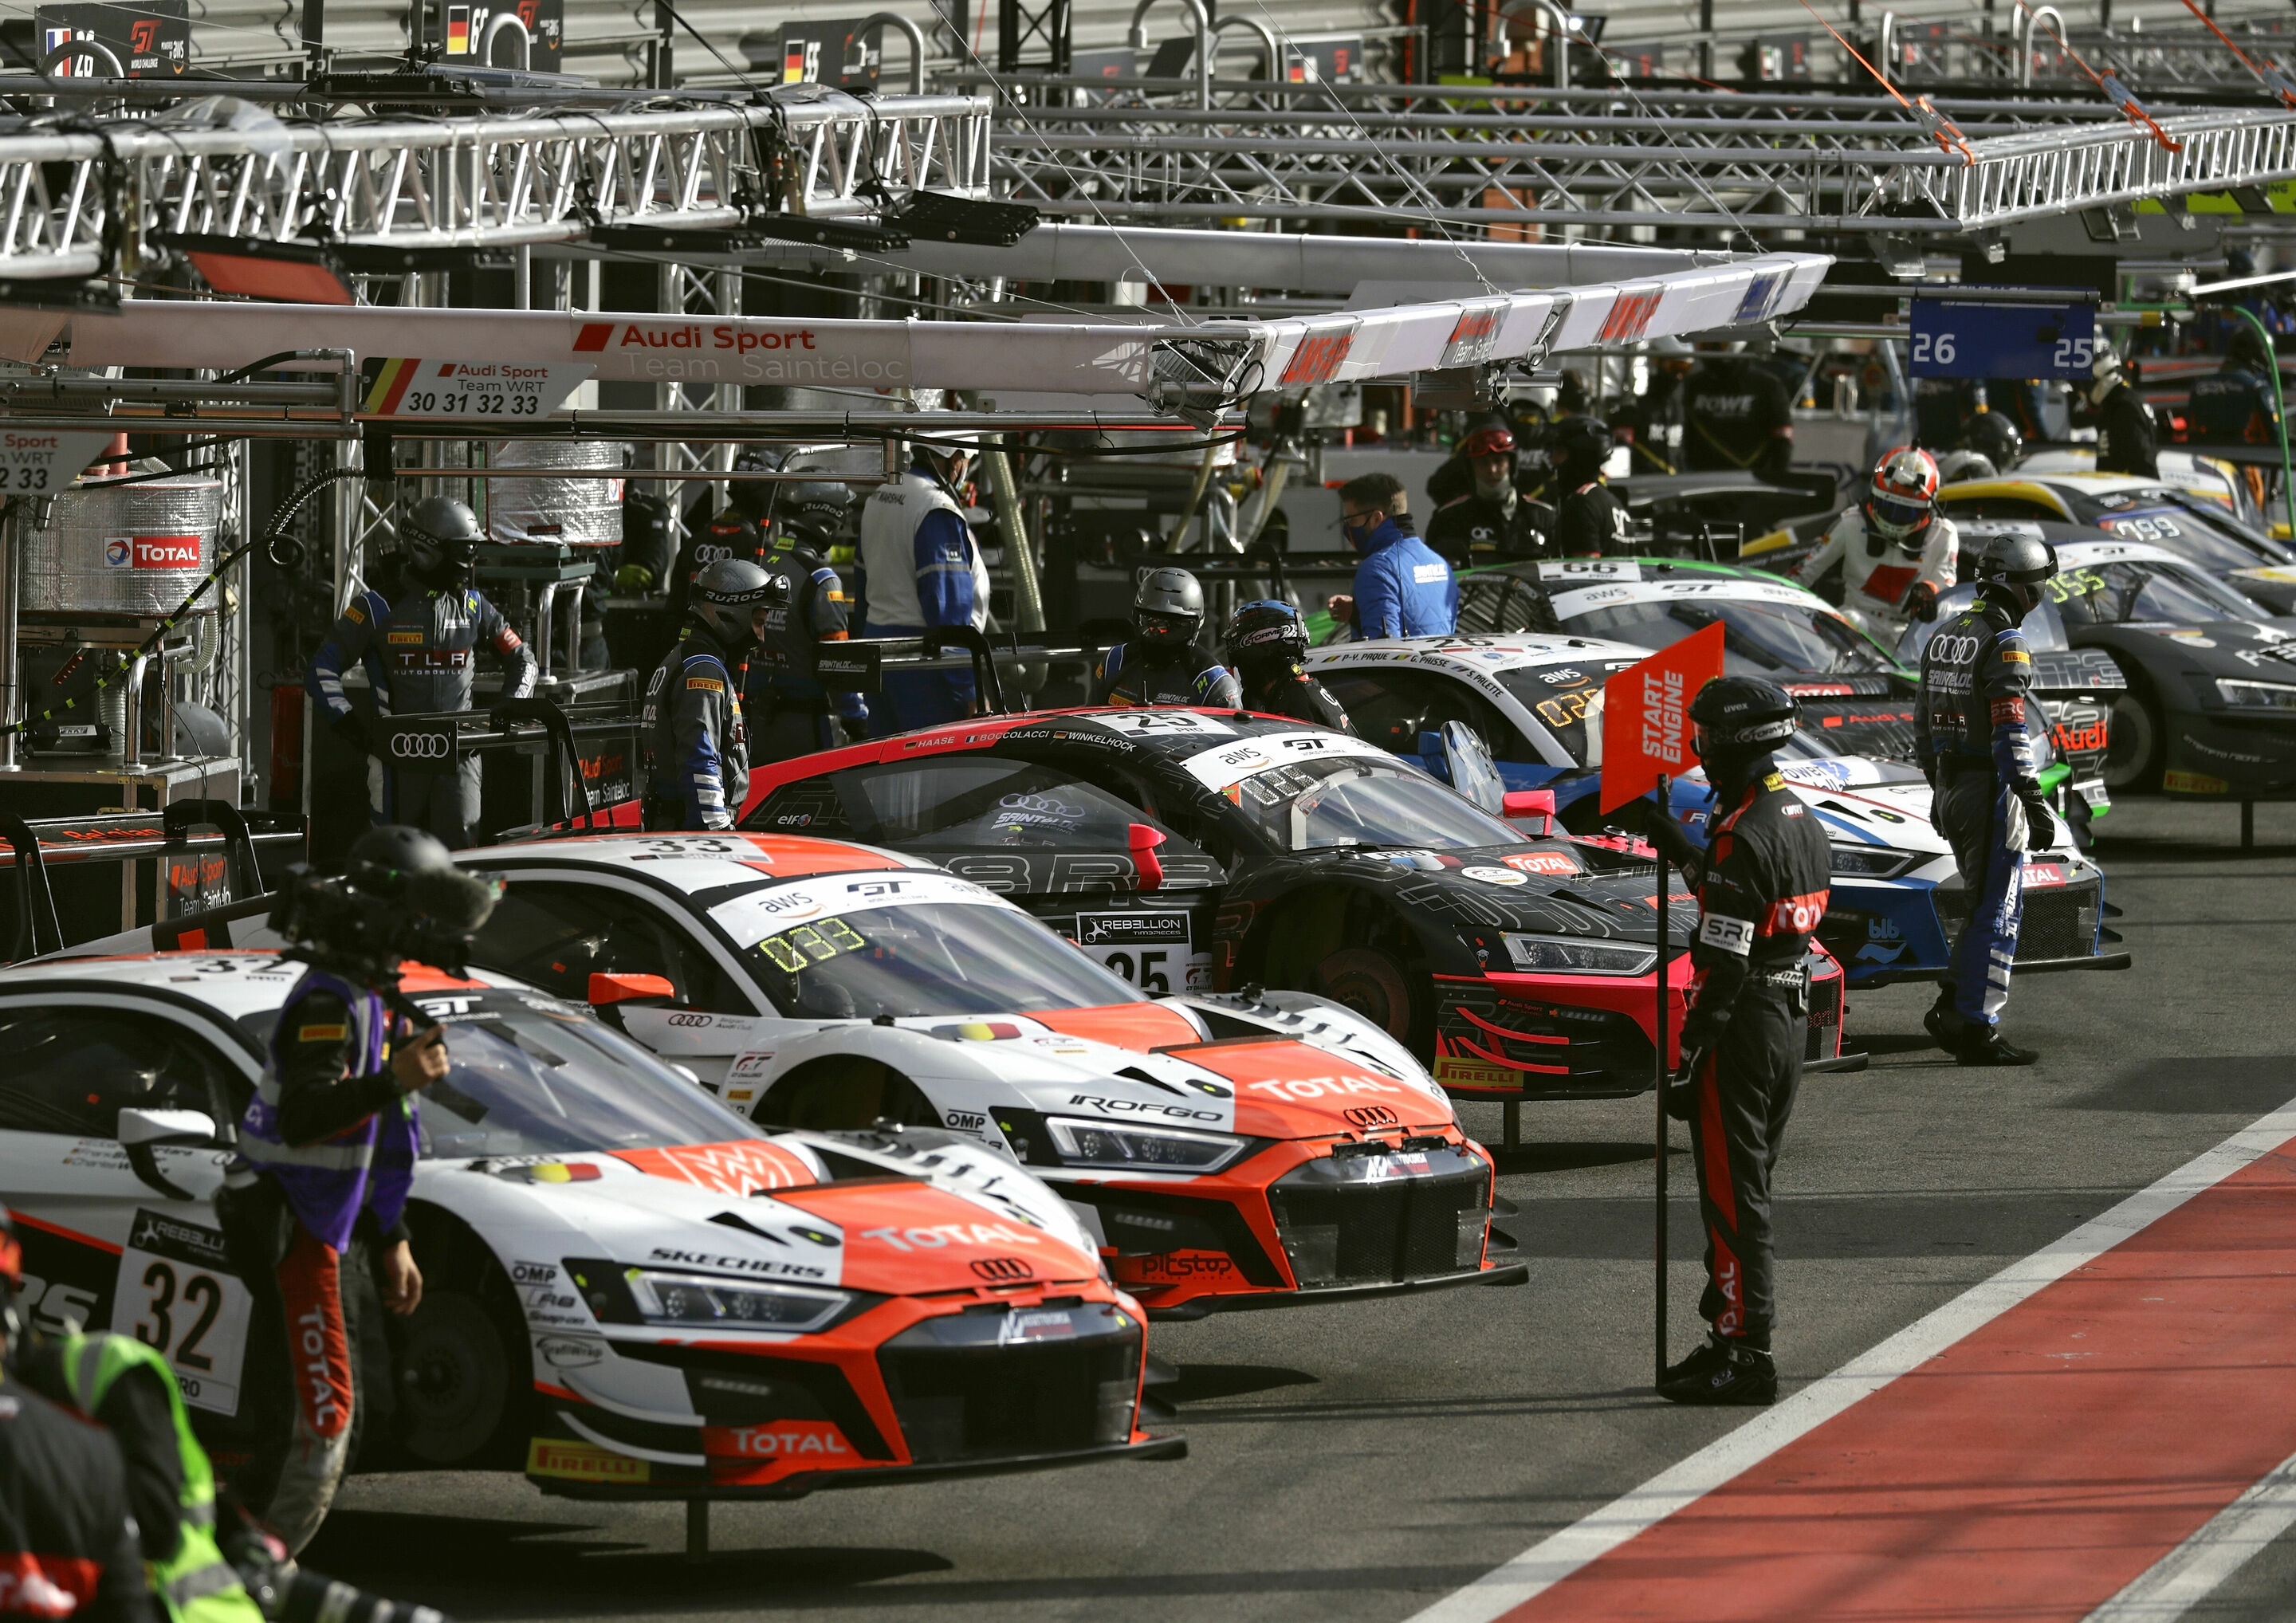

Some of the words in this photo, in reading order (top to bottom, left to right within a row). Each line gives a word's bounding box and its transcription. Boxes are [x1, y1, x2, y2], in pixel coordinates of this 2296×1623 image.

[804, 42, 821, 83] 55
[620, 325, 702, 349] Audi
[714, 327, 816, 355] Sport
[1913, 332, 1956, 364] 26
[2054, 338, 2093, 368] 25
[458, 364, 495, 376] Audi
[501, 366, 548, 379] Sport
[621, 352, 719, 379] Team
[742, 352, 904, 380] Saintéloc
[458, 379, 501, 391] Team
[506, 381, 545, 392] WRT
[409, 392, 435, 411] 30
[442, 394, 468, 412] 31
[478, 395, 504, 414] 32
[512, 395, 538, 415] 33
[4, 434, 57, 450] Sport
[11, 452, 55, 464] WRT
[18, 467, 47, 489] 33
[879, 492, 906, 505] MARSHAL
[2117, 517, 2180, 541] 799
[136, 544, 198, 561] TOTAL
[1563, 563, 1618, 572] 66
[1584, 588, 1628, 601] aws
[1661, 583, 1728, 592] GT
[1244, 626, 1292, 646] STORMER
[1362, 652, 1388, 662] PAQUE
[1418, 655, 1450, 668] PAISSE
[1539, 668, 1582, 685] aws
[688, 680, 722, 691] PIRELLI
[1642, 673, 1663, 758] START
[1724, 702, 1748, 713] uvex
[1117, 713, 1197, 728] 25
[1662, 670, 1683, 764] ENGINE
[918, 737, 955, 748] HAASE
[979, 730, 1049, 742] BOCCOLACCI
[1067, 732, 1137, 753] WINKELHOCK
[1283, 738, 1329, 750] GT
[2053, 721, 2107, 750] Audi
[1219, 748, 1261, 764] aws
[1779, 764, 1827, 780] Power
[587, 789, 600, 806] eam
[777, 815, 798, 826] elf
[62, 827, 165, 841] Belgian
[1038, 824, 1072, 835] RACING
[648, 839, 733, 853] 33
[1508, 858, 1575, 874] TOTAL
[2023, 869, 2059, 882] TAL
[847, 881, 910, 895] GT
[179, 897, 200, 917] Team
[759, 891, 812, 914] aws
[1103, 919, 1181, 930] REBELLION
[1869, 918, 1899, 939] blb
[196, 958, 293, 974] 32
[1441, 1062, 1514, 1082] PIRELLI
[1248, 1075, 1401, 1101] TOTAL
[946, 1114, 985, 1130] OMP
[159, 1220, 225, 1251] REBELLI
[862, 1224, 1041, 1252] TOTAL
[649, 1248, 826, 1279] SKECHERS
[1142, 1253, 1232, 1275] pitstop
[513, 1266, 556, 1282] OMP
[136, 1262, 222, 1373] 32
[299, 1305, 336, 1426] TOTAL
[179, 1377, 200, 1398] RO
[730, 1428, 847, 1453] TOTAL
[536, 1445, 637, 1475] PIRELLI
